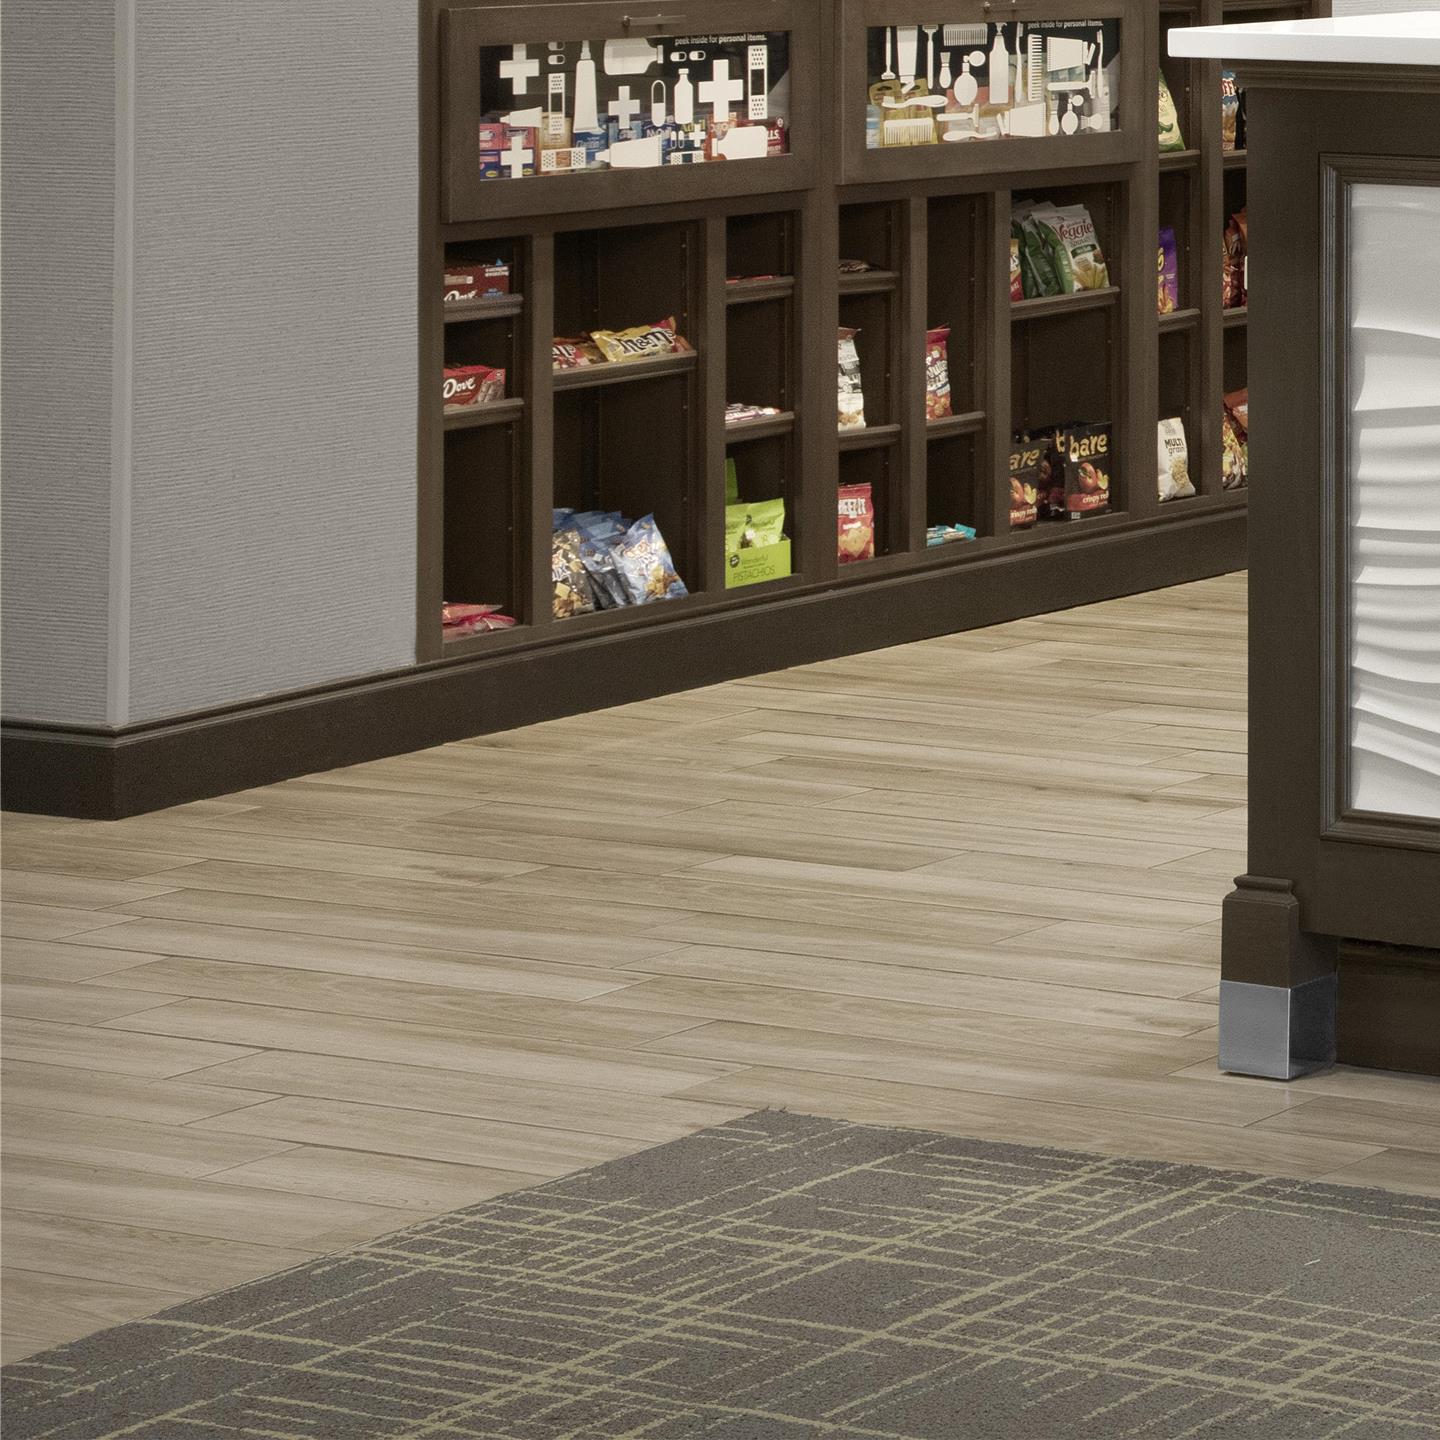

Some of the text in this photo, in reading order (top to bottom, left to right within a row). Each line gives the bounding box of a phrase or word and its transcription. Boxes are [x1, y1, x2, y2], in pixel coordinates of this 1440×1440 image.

[719, 34, 746, 44] personal
[1052, 222, 1093, 241] Veggie
[443, 376, 476, 398] Dove
[1069, 433, 1108, 461] bare
[1164, 437, 1184, 449] MULTI
[1009, 449, 1040, 471] are
[733, 564, 775, 582] PISTACHIOS
